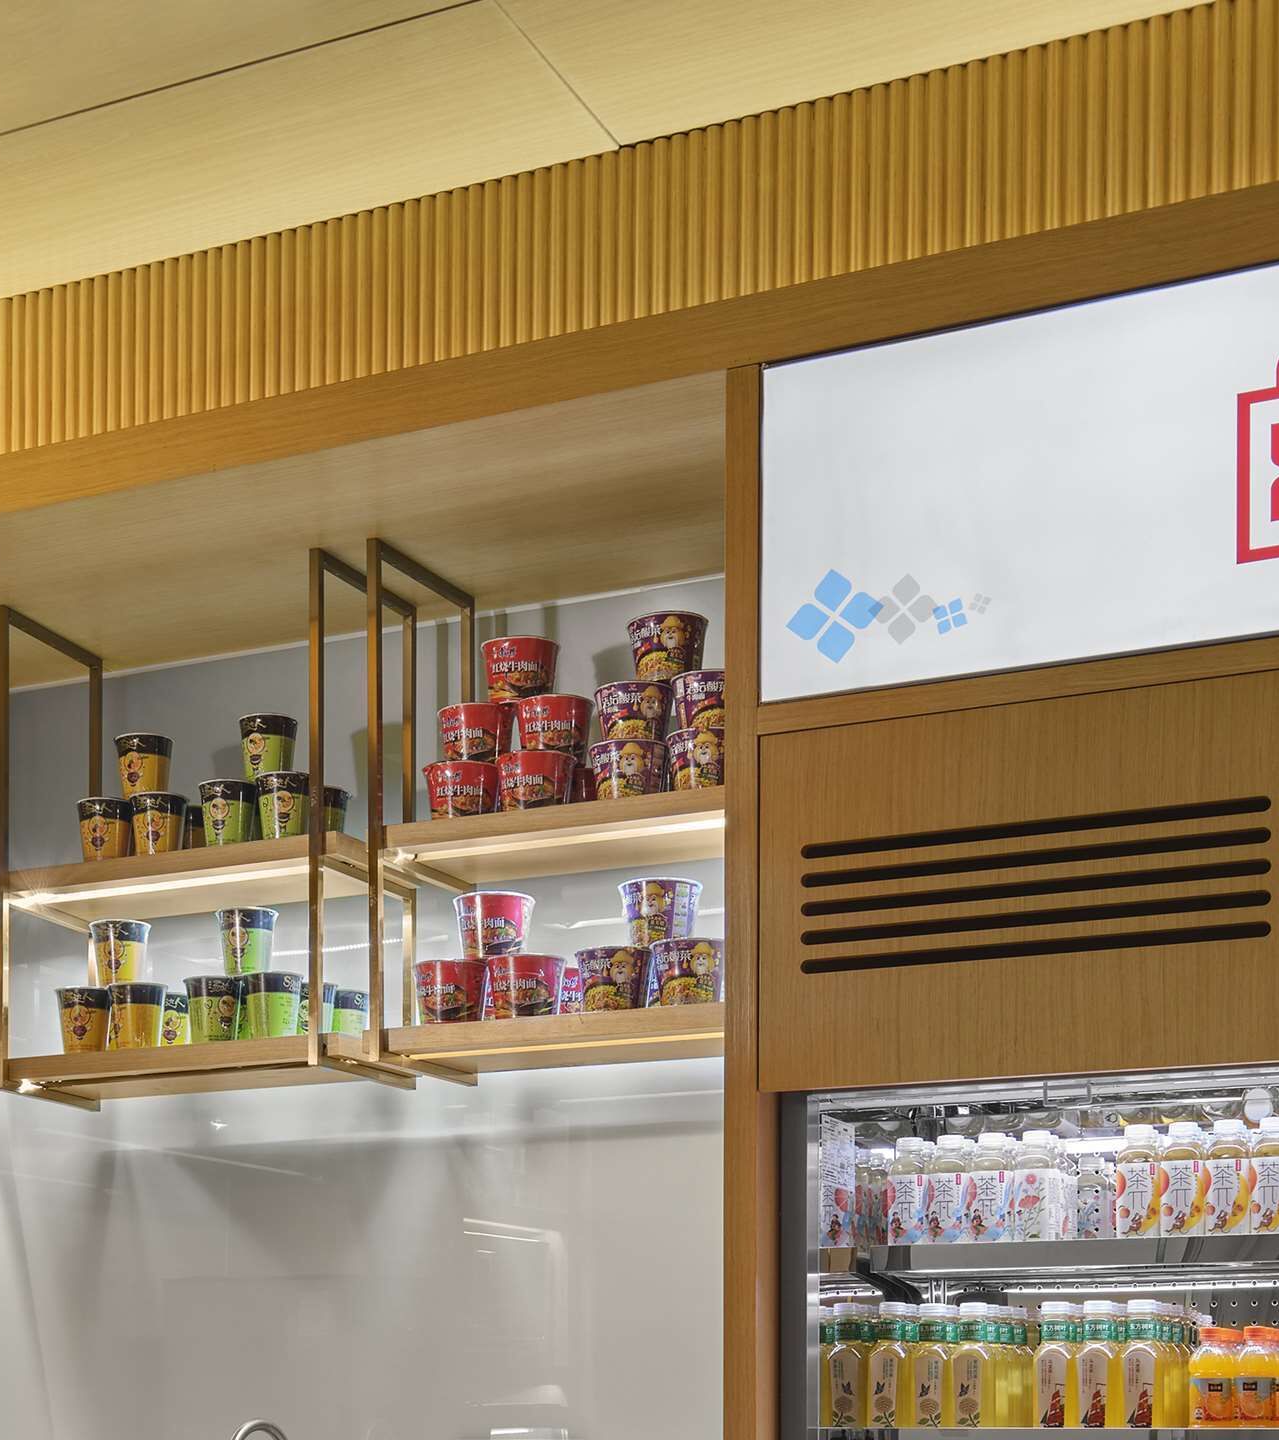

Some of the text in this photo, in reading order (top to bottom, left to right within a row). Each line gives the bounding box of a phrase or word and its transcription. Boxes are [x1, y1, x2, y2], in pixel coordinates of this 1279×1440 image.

[491, 660, 539, 674] 红烧牛肉面
[524, 720, 572, 733] 红烧牛肉面
[435, 785, 483, 797] 红烧牛肉面
